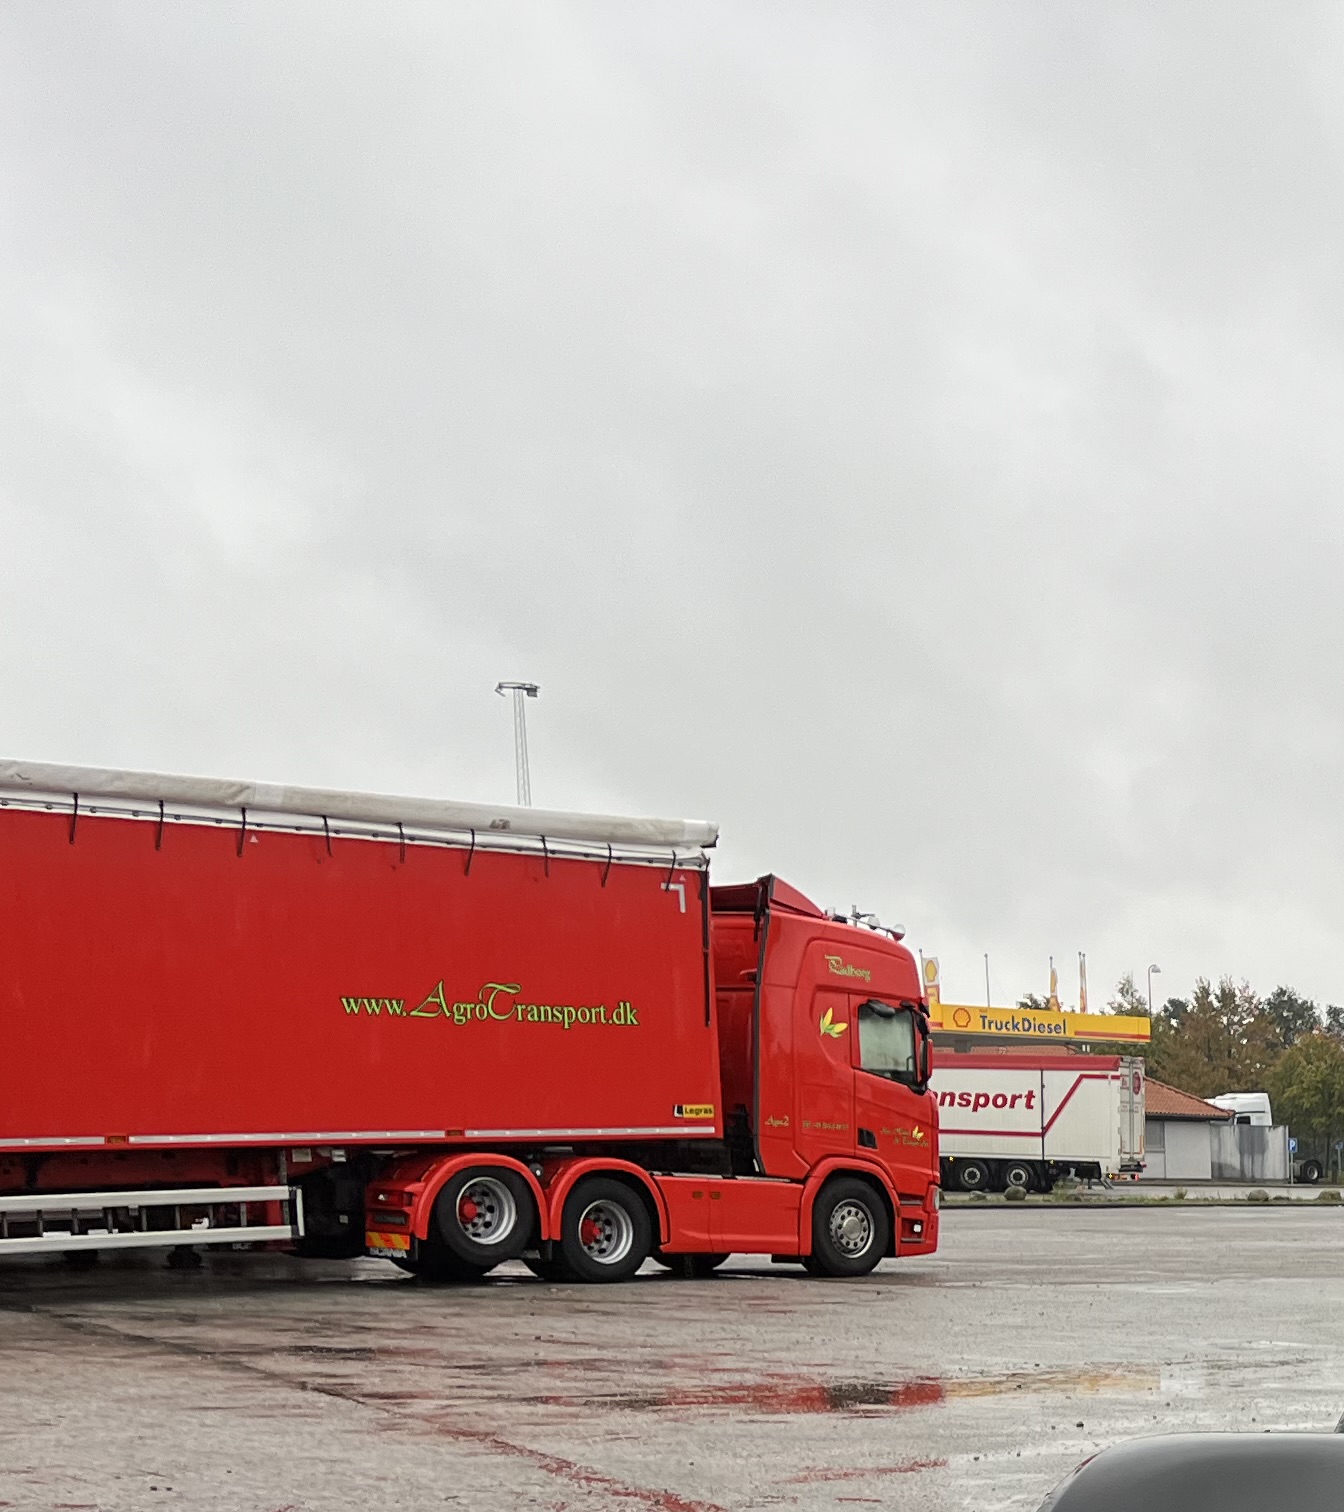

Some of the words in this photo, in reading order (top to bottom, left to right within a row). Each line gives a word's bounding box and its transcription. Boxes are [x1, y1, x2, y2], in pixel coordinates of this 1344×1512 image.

[341, 980, 640, 1029] www.AgroTransport.dk
[979, 1014, 1066, 1035] TruckDiesel
[684, 1106, 713, 1116] Legras
[932, 1090, 1036, 1112] nsport
[1289, 1139, 1296, 1150] P
